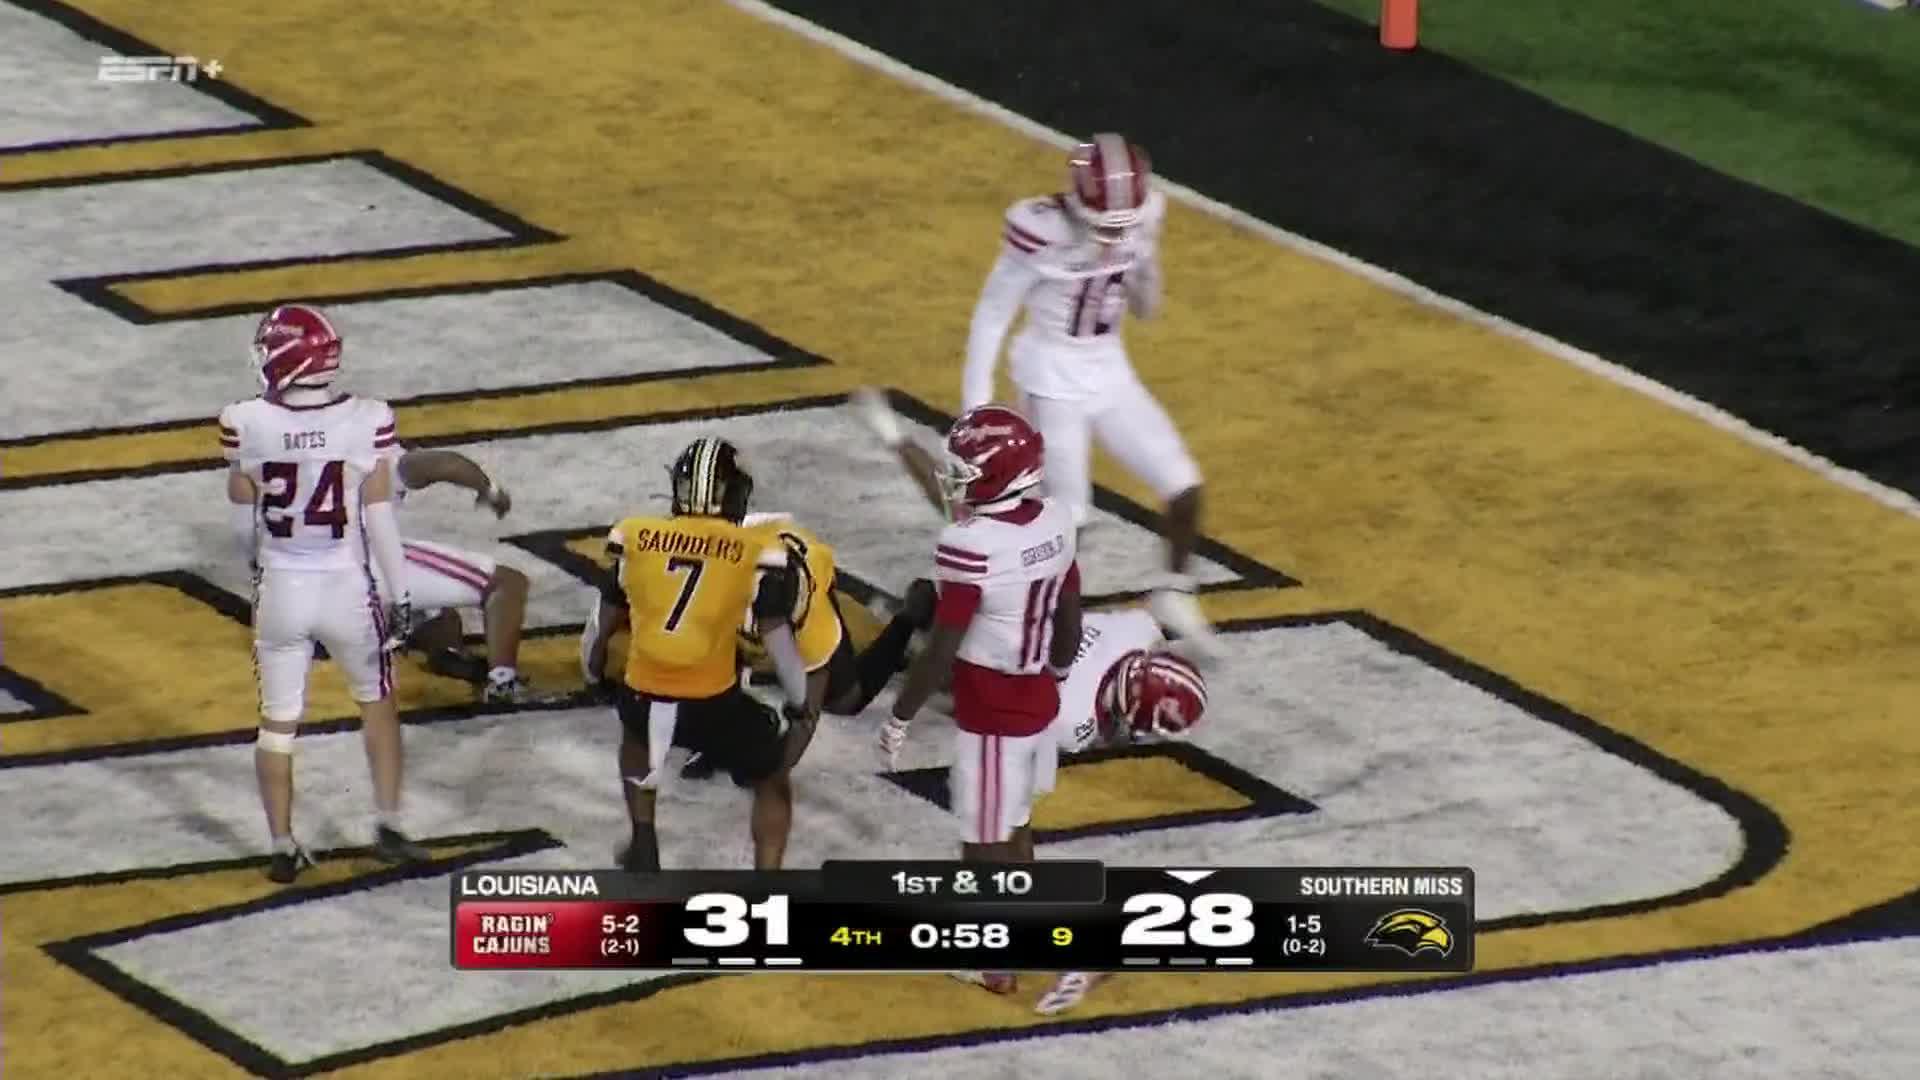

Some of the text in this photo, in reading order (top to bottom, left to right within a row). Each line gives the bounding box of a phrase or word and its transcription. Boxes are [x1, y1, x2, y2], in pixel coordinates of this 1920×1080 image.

[283, 431, 326, 451] BATES
[261, 458, 348, 539] 24
[637, 527, 744, 567] SAUNDERS
[664, 554, 705, 635] 7
